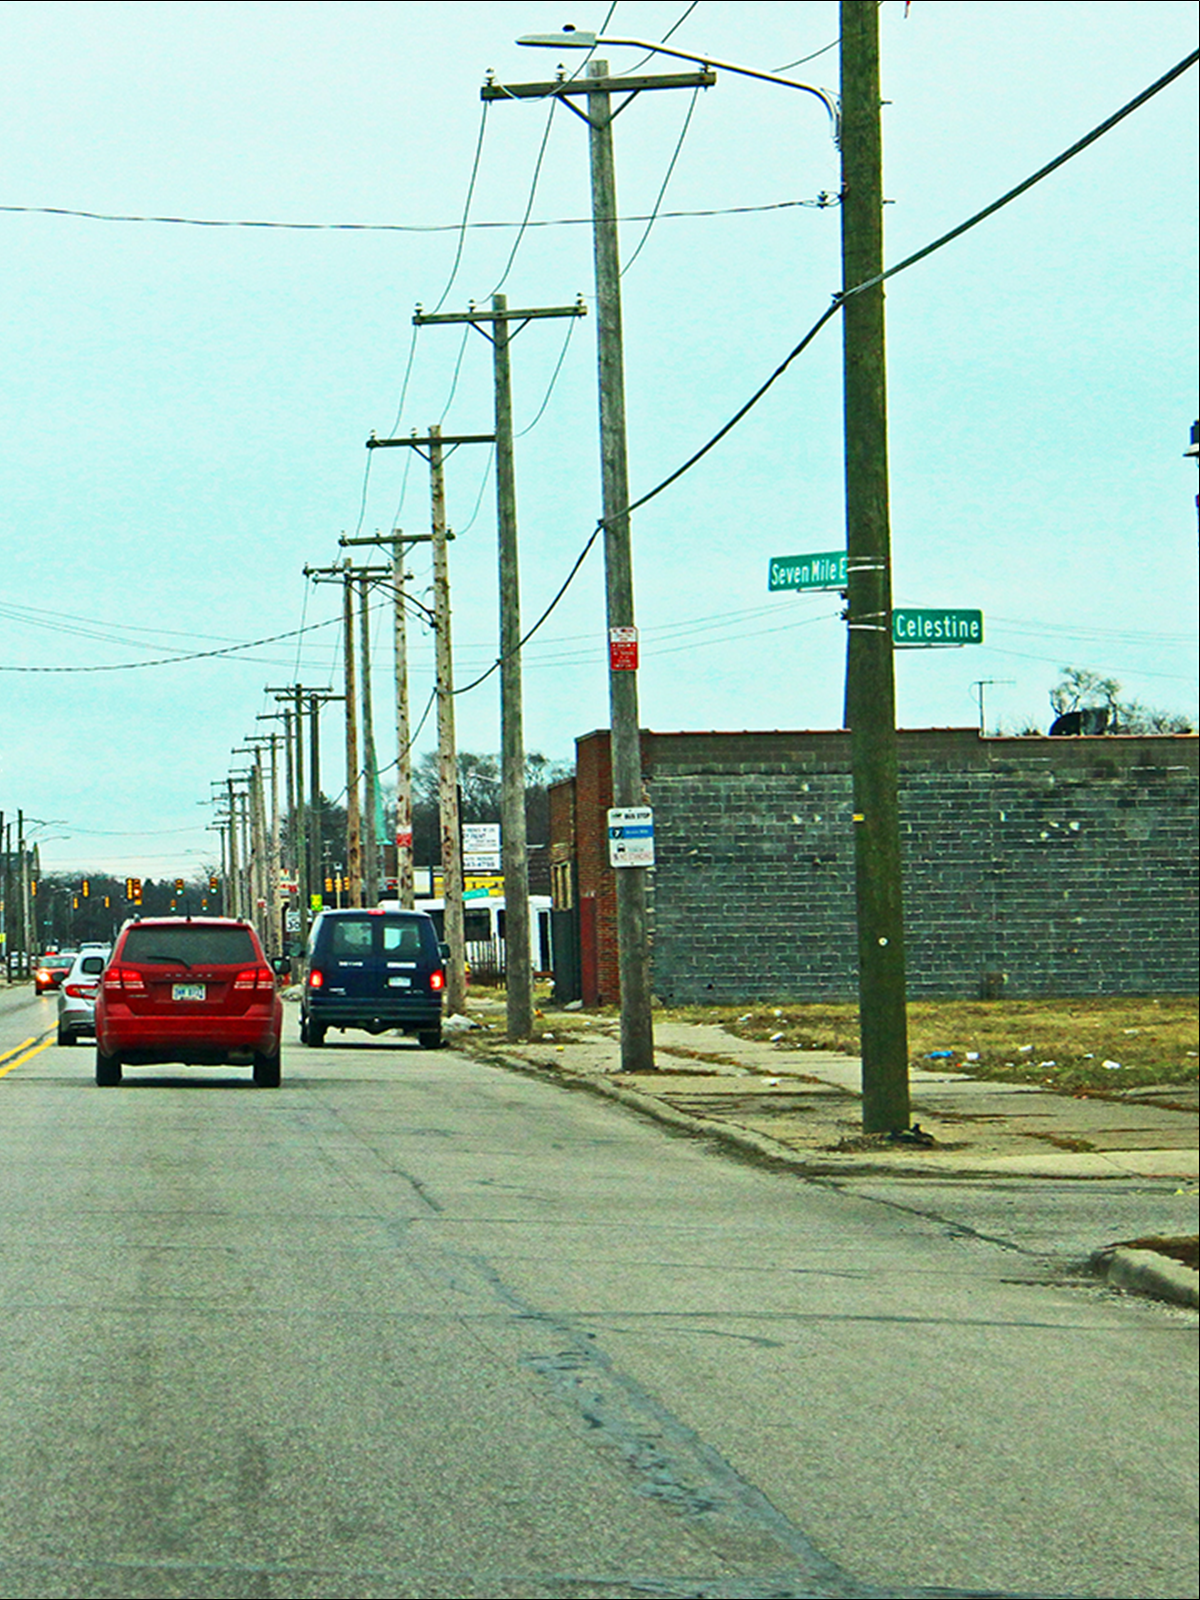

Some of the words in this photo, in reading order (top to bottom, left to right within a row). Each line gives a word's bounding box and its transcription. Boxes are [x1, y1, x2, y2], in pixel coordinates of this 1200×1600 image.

[771, 563, 809, 586] Seven
[811, 559, 836, 582] Mile
[896, 614, 979, 638] Celestine
